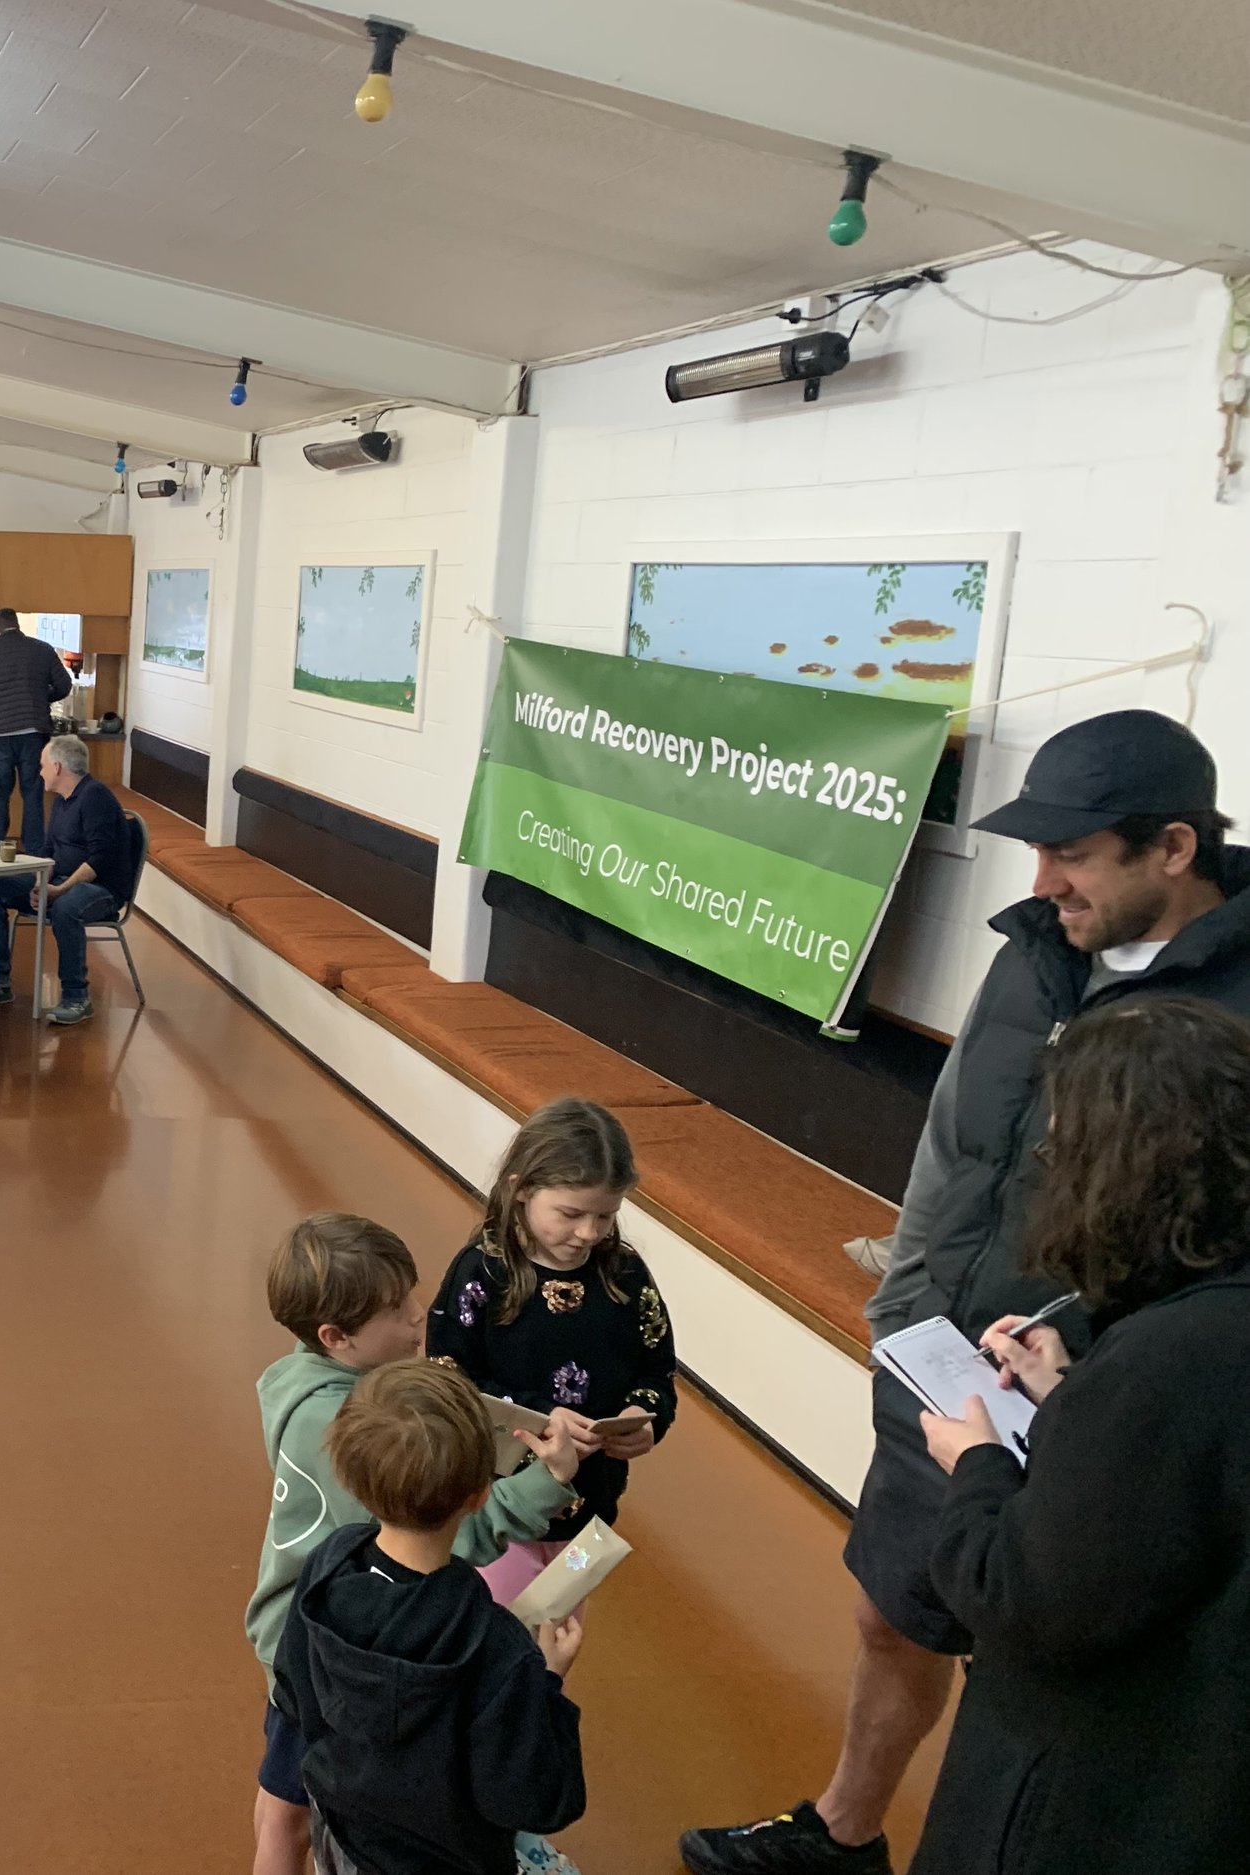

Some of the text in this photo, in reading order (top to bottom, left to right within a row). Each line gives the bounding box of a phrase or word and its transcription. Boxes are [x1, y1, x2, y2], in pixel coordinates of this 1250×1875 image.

[515, 691, 908, 826] Milford Recovery Project 2025:
[518, 810, 850, 972] Creating Our Shared Future
